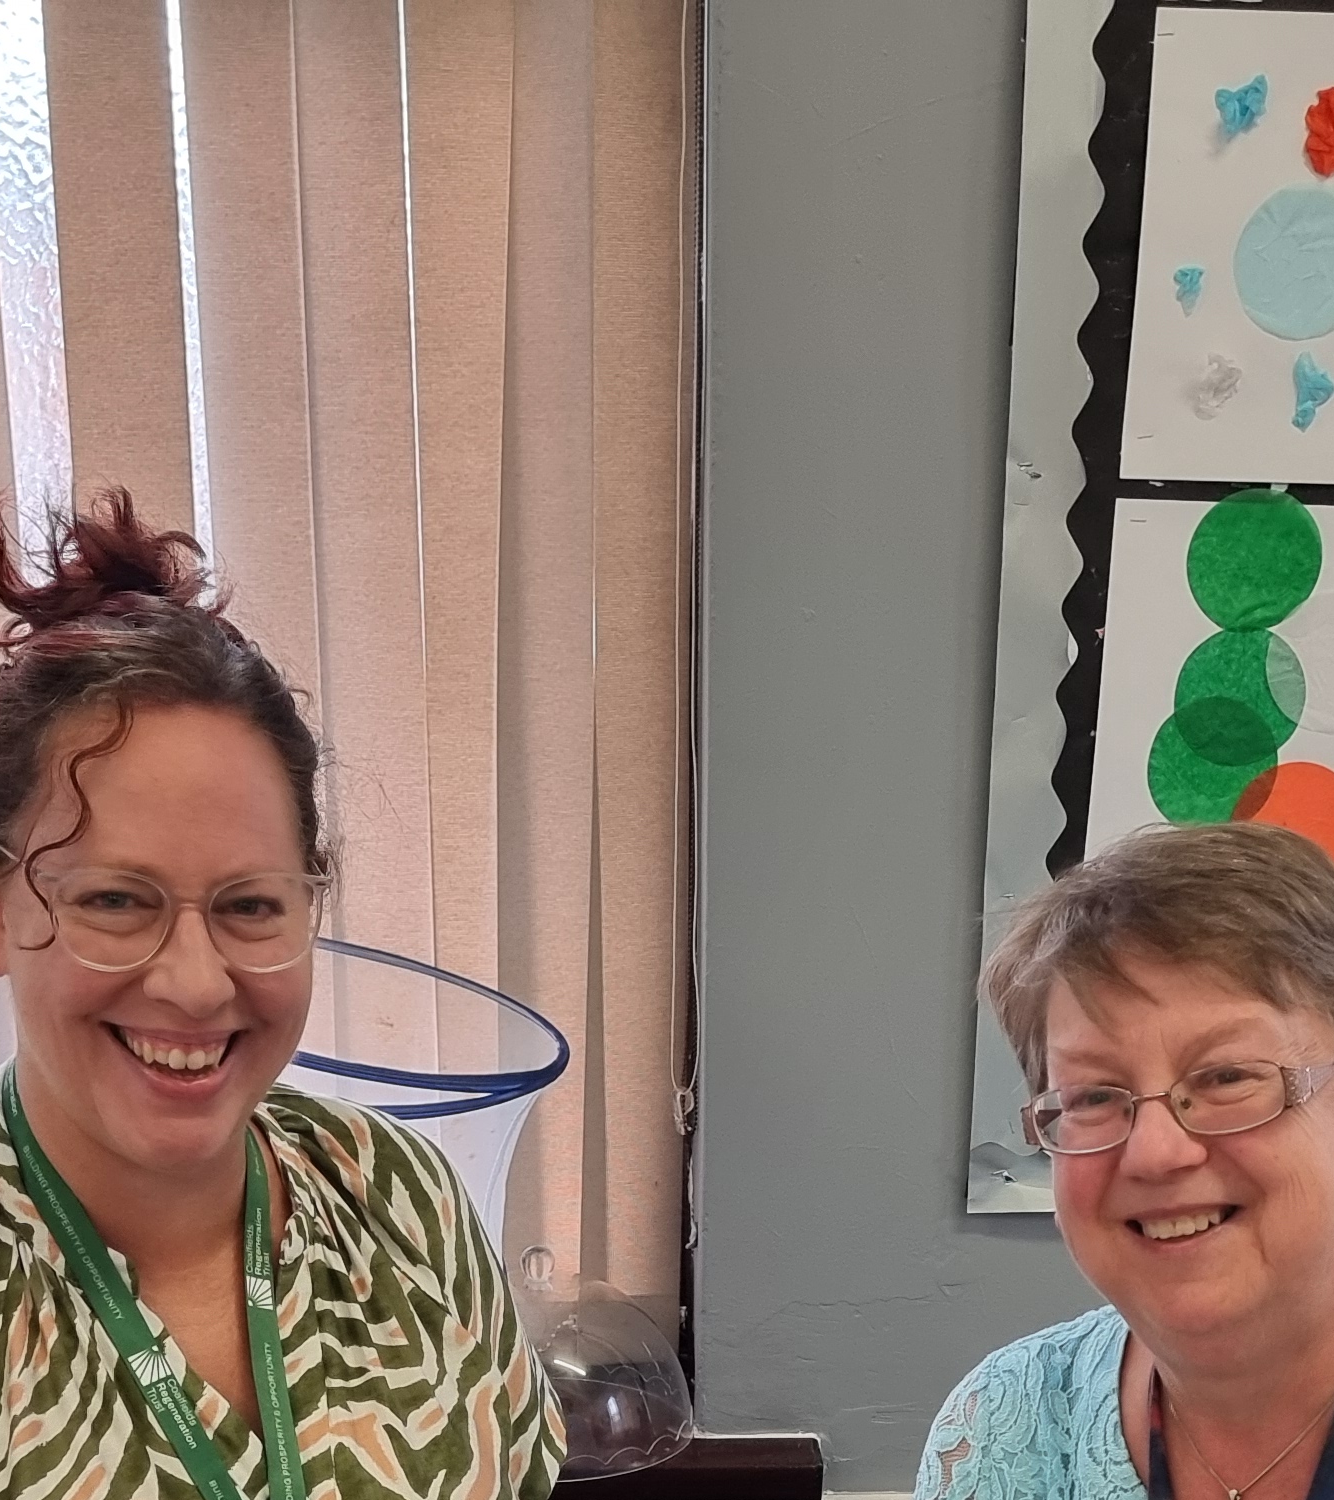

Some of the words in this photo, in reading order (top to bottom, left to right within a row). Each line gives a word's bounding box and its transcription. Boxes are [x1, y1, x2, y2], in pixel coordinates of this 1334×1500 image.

[22, 1145, 47, 1188] BUILDING
[46, 1187, 82, 1248] PROSPERITY
[81, 1255, 125, 1320] OPPORTUNITY
[146, 1386, 166, 1414] Trust
[167, 1378, 197, 1427] Coalfields
[264, 1341, 281, 1410] OPPORTUNITY
[156, 1382, 197, 1450] Regeneration
[274, 1418, 291, 1477] PROSPERITY
